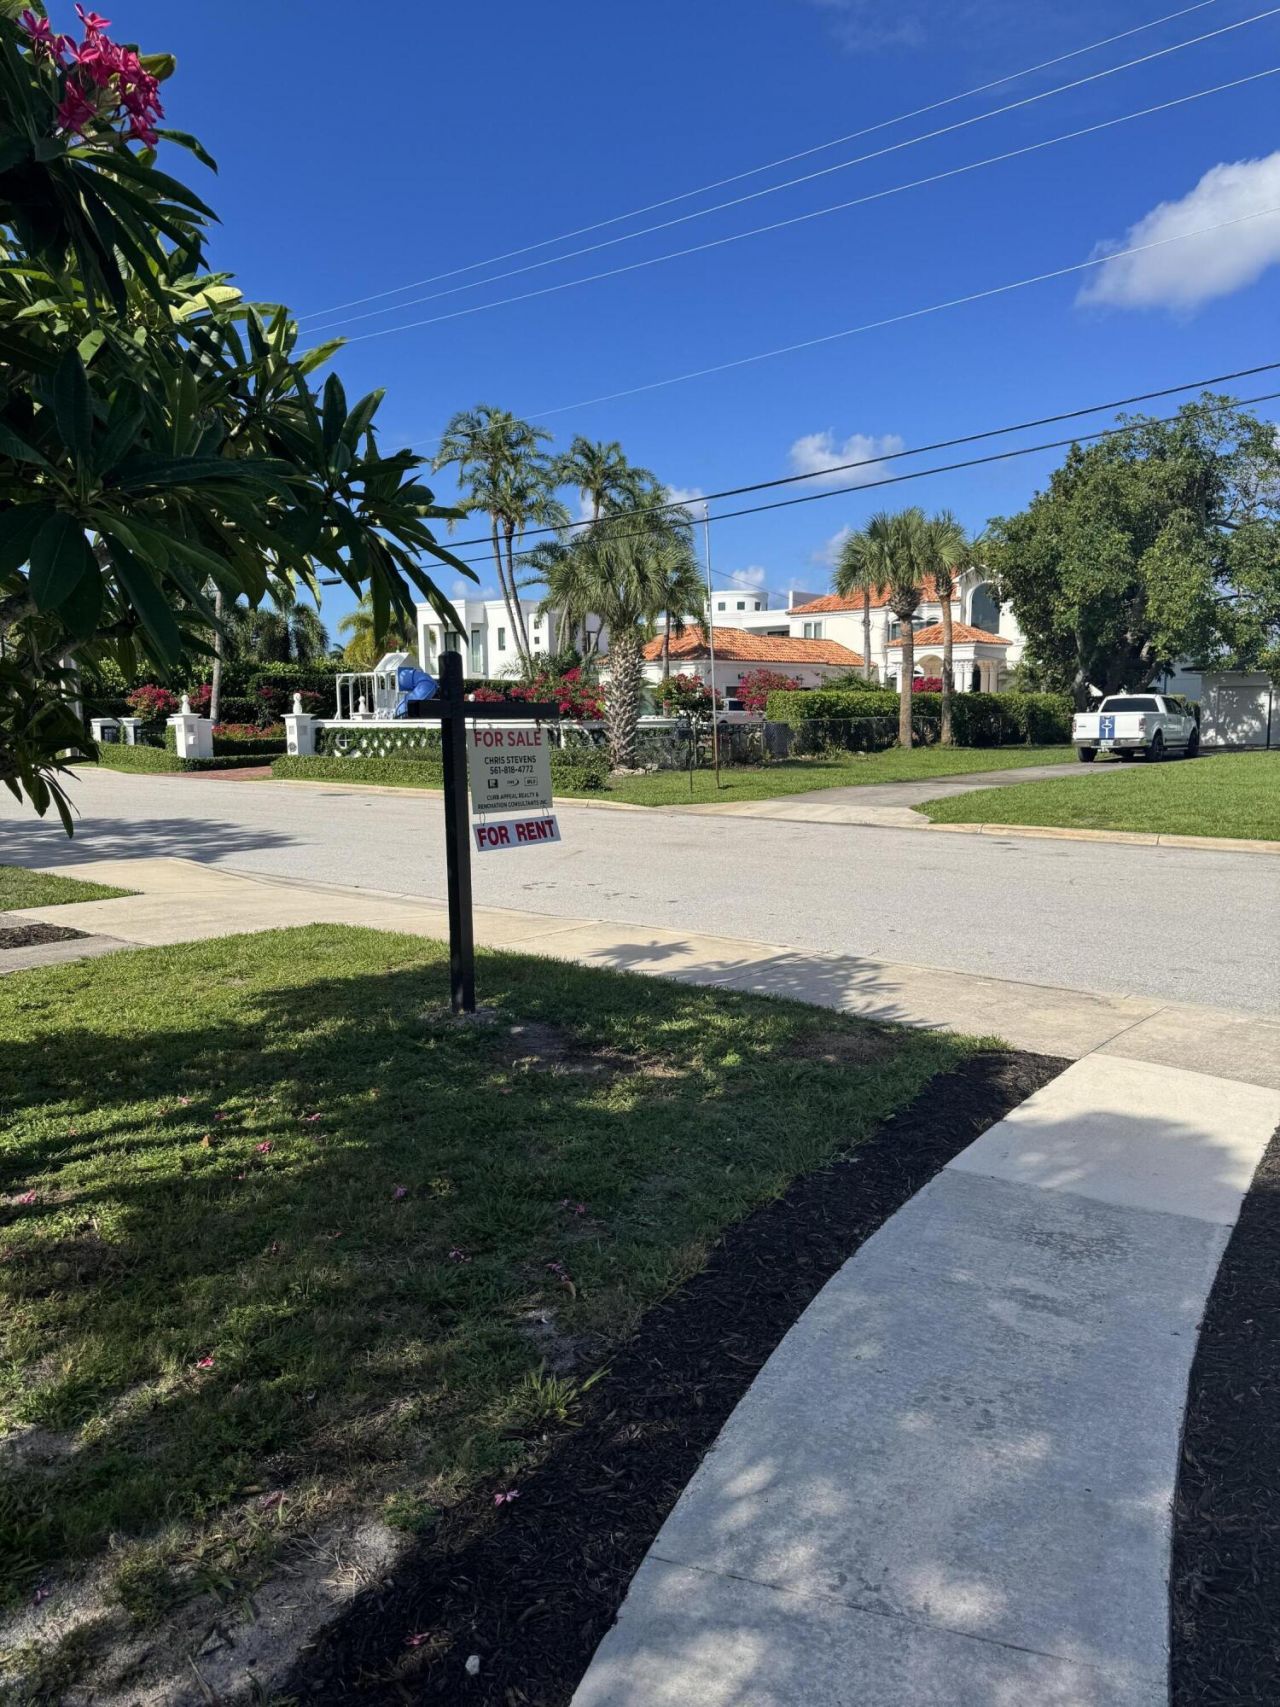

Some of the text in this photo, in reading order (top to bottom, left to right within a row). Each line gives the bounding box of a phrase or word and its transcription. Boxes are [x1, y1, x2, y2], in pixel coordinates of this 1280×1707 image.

[474, 730, 542, 747] FOR SALE
[484, 755, 537, 765] CHRIS STEVENS
[490, 765, 534, 775] 561-818-4772
[478, 801, 508, 809] RENOVATION
[508, 799, 539, 808] CONSULTANTS
[477, 819, 554, 847] FOR RENT
